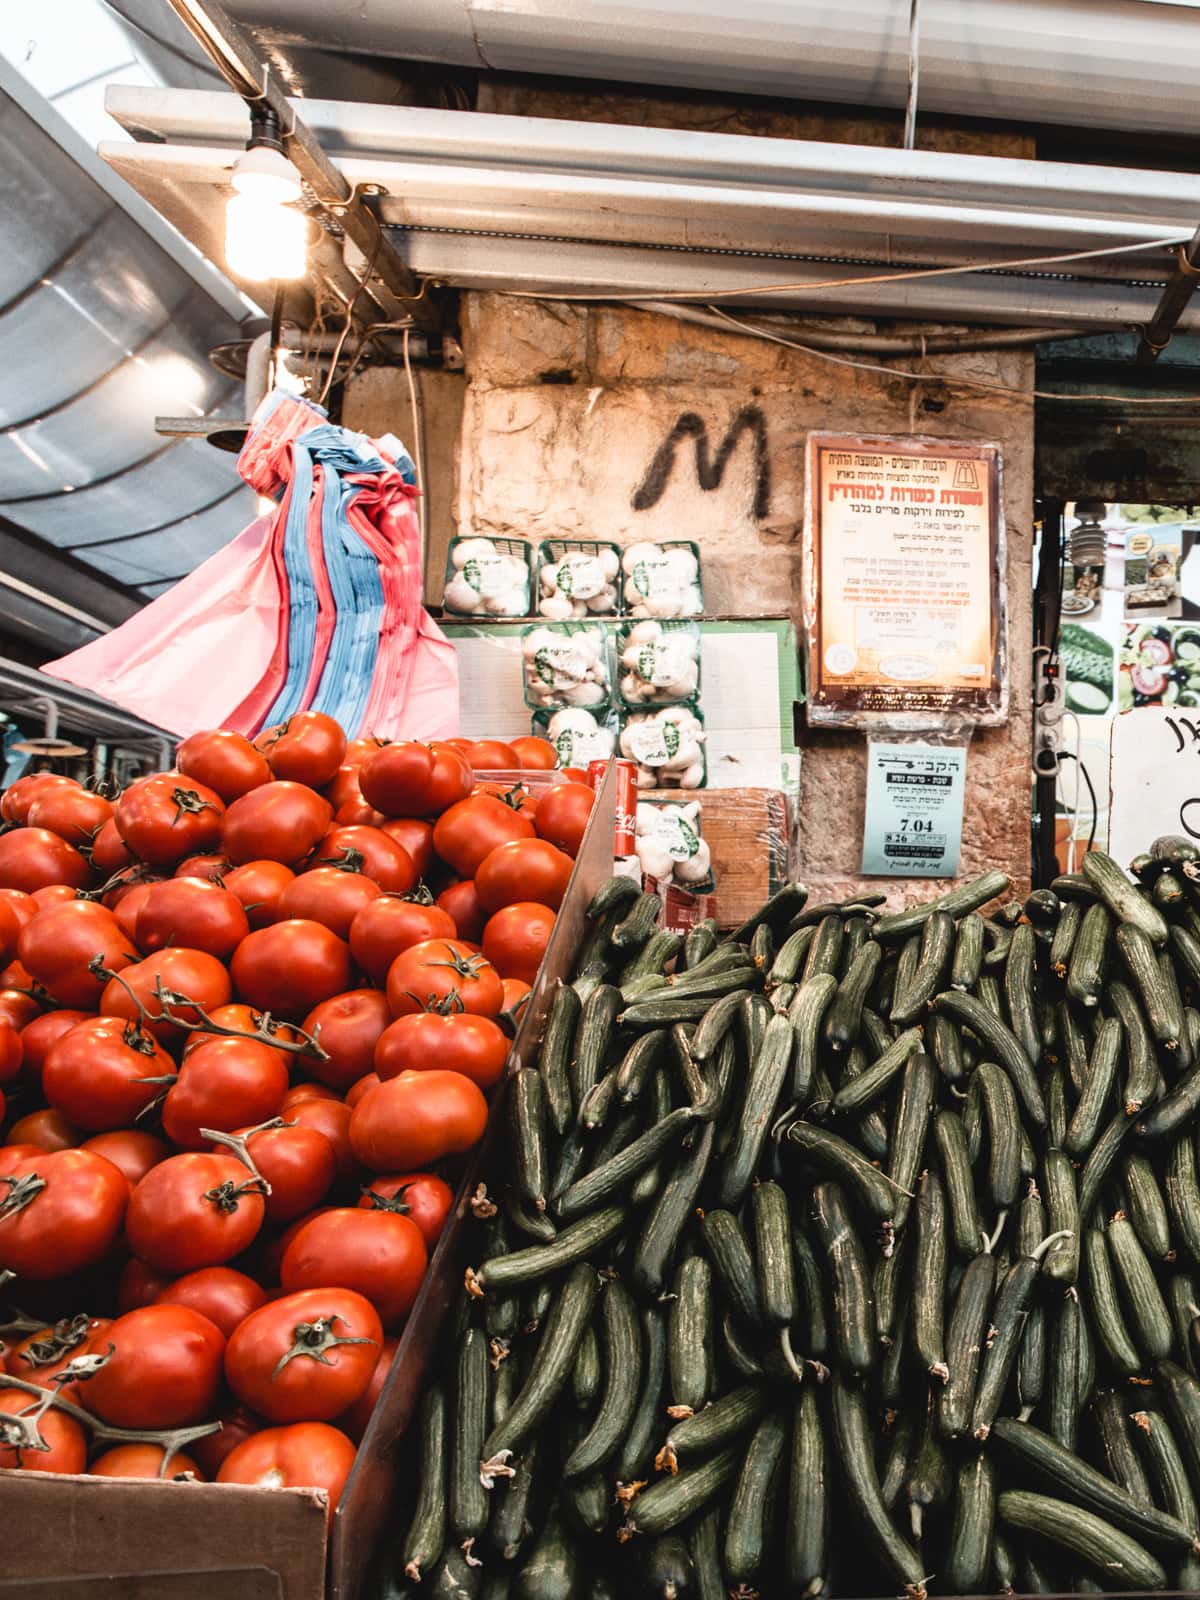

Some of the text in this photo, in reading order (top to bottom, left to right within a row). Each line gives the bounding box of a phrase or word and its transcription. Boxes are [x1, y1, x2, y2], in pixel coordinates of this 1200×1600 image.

[828, 483, 885, 502] למהדרין
[890, 486, 935, 503] כשרות
[849, 503, 873, 514] בלבד
[903, 505, 932, 519] וירקות
[935, 507, 965, 519] לפירות
[900, 818, 933, 833] 7.04
